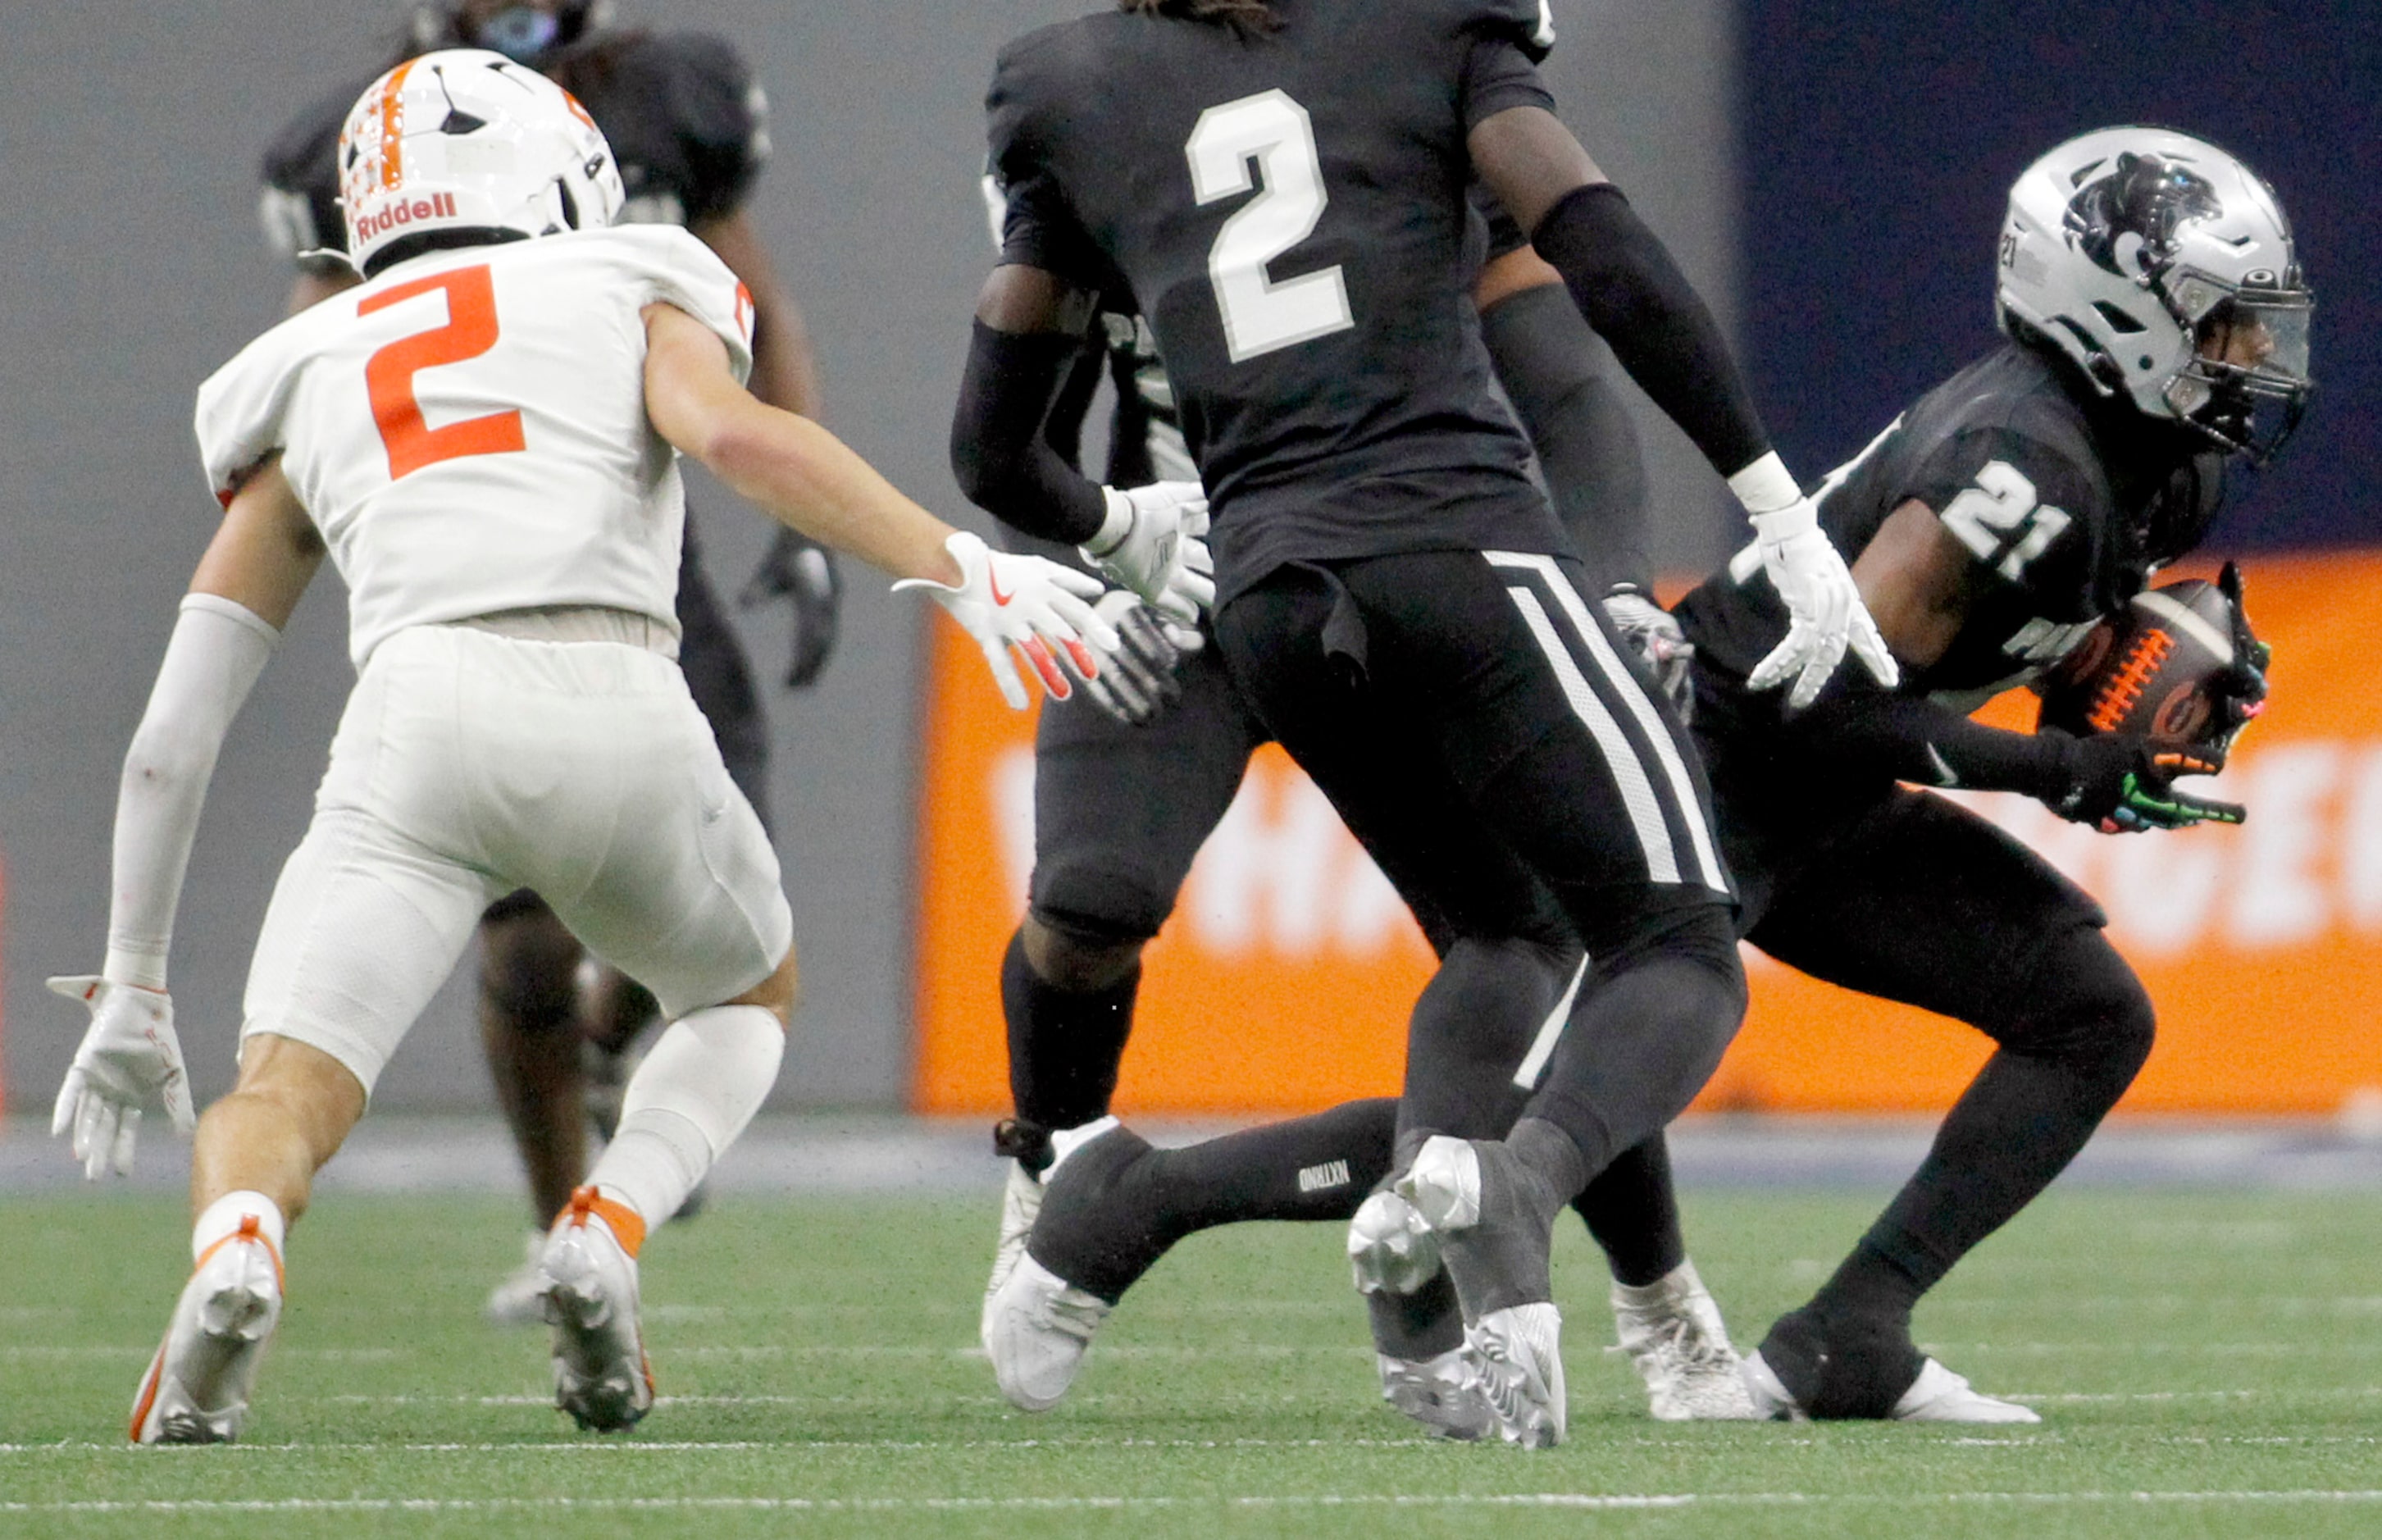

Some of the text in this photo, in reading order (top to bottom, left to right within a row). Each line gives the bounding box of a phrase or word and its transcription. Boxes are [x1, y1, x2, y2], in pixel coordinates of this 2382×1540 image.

[357, 192, 457, 245] Riddell
[1185, 88, 1355, 363] 2
[357, 262, 526, 481] 2
[1939, 459, 2072, 581] 21
